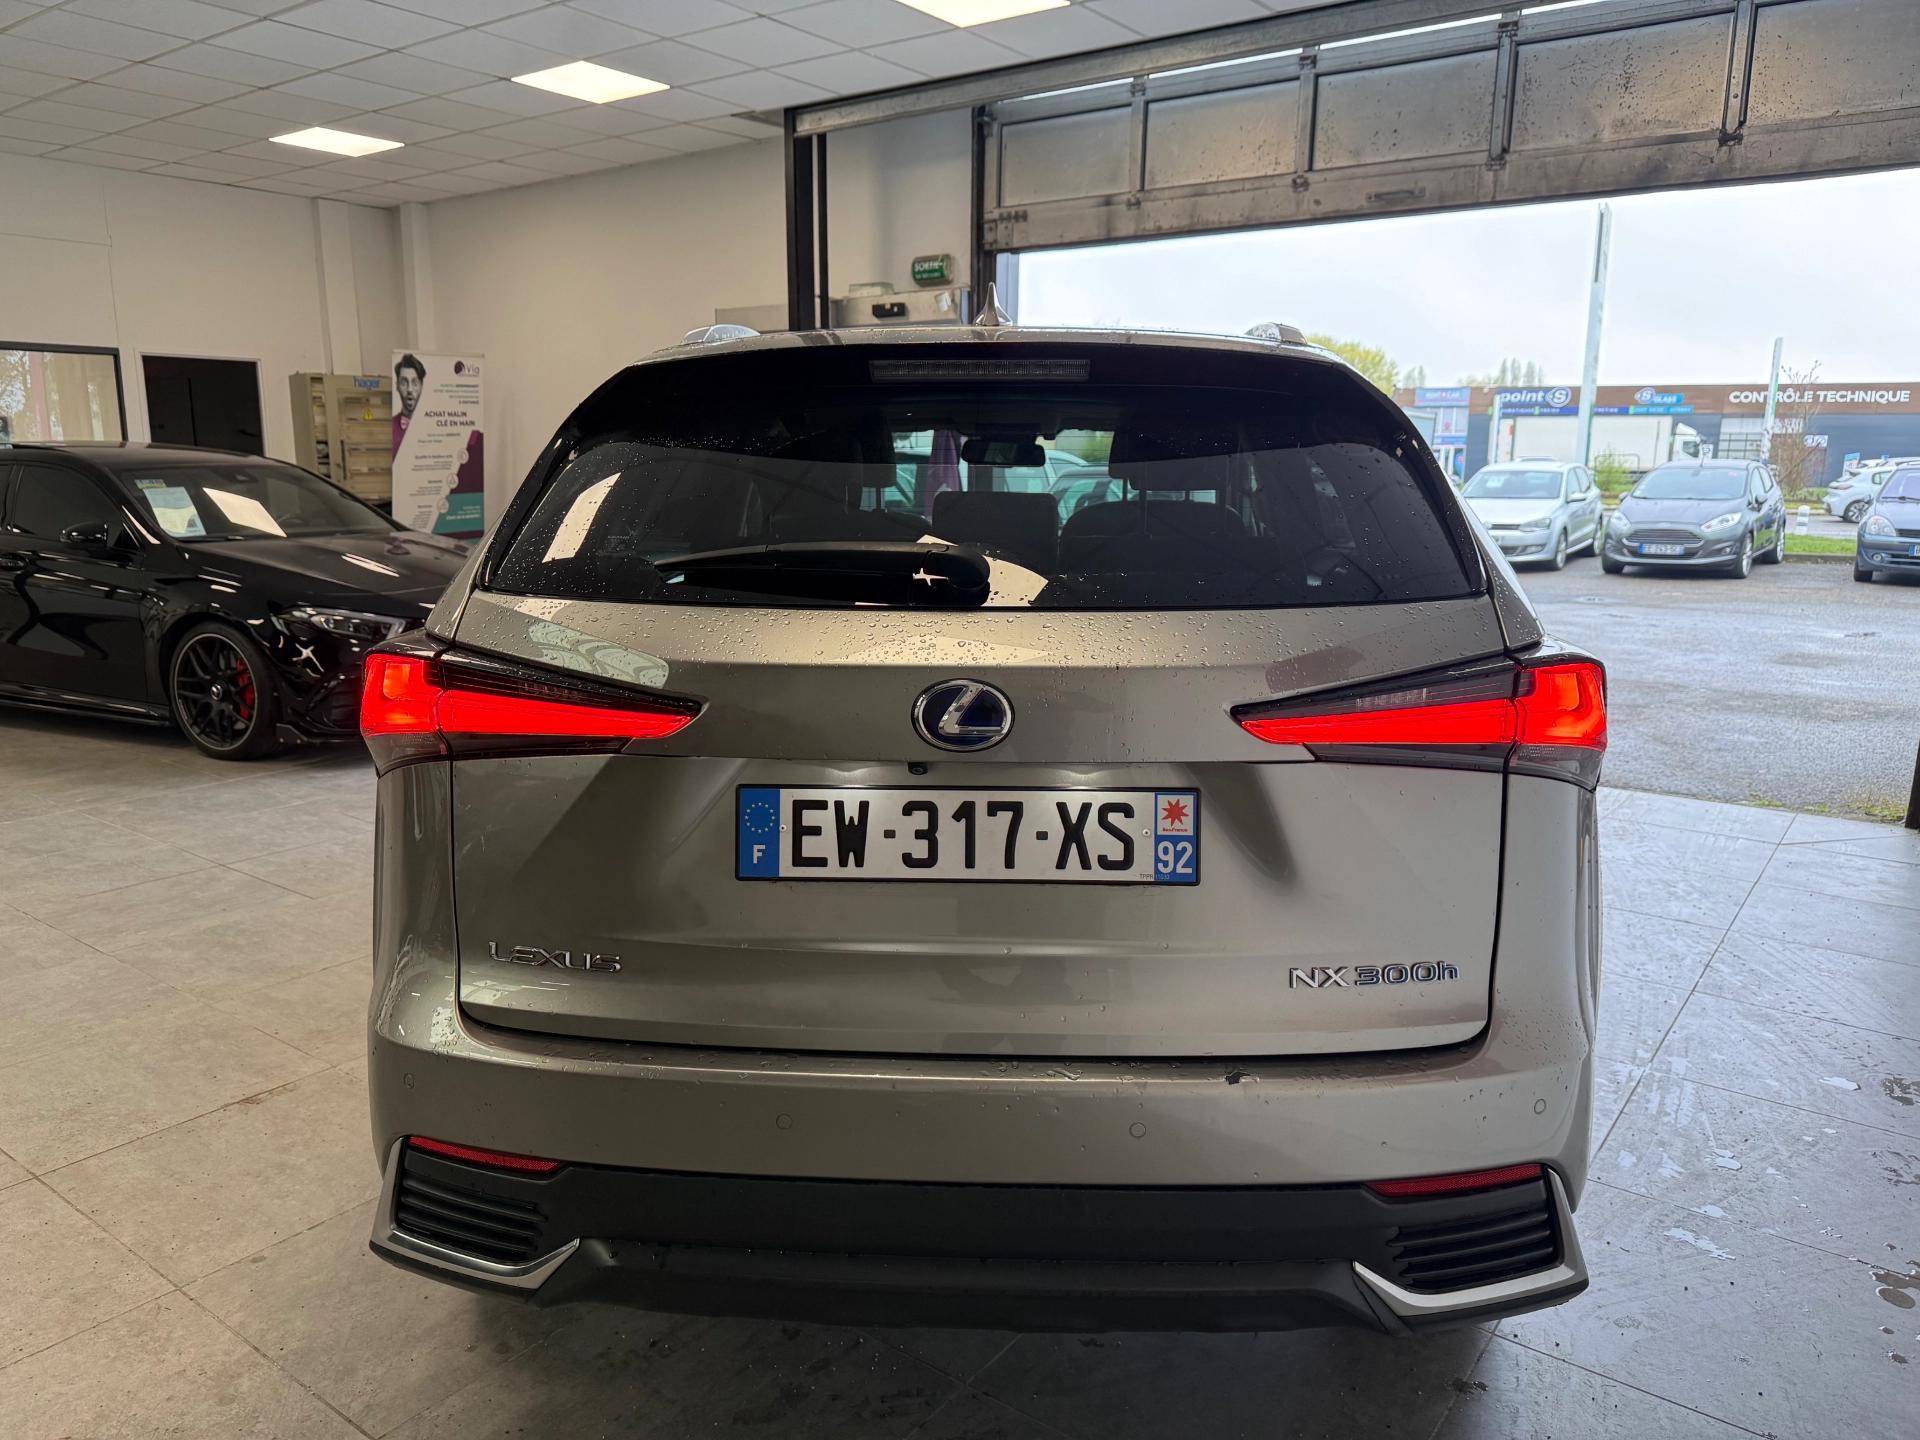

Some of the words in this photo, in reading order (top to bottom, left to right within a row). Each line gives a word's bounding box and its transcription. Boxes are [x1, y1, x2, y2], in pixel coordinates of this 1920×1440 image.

[1501, 390, 1545, 403] point
[1817, 390, 1911, 404] TECHNIQUE
[424, 410, 446, 418] ACHAT
[447, 410, 467, 418] MALIN
[436, 419, 448, 427] CLÉ
[791, 798, 1136, 872] EW-317-XS
[752, 844, 766, 864] F
[1157, 841, 1193, 874] 92
[488, 940, 622, 973] LEXUS
[1289, 966, 1350, 989] NX
[1355, 961, 1460, 986] 300h
